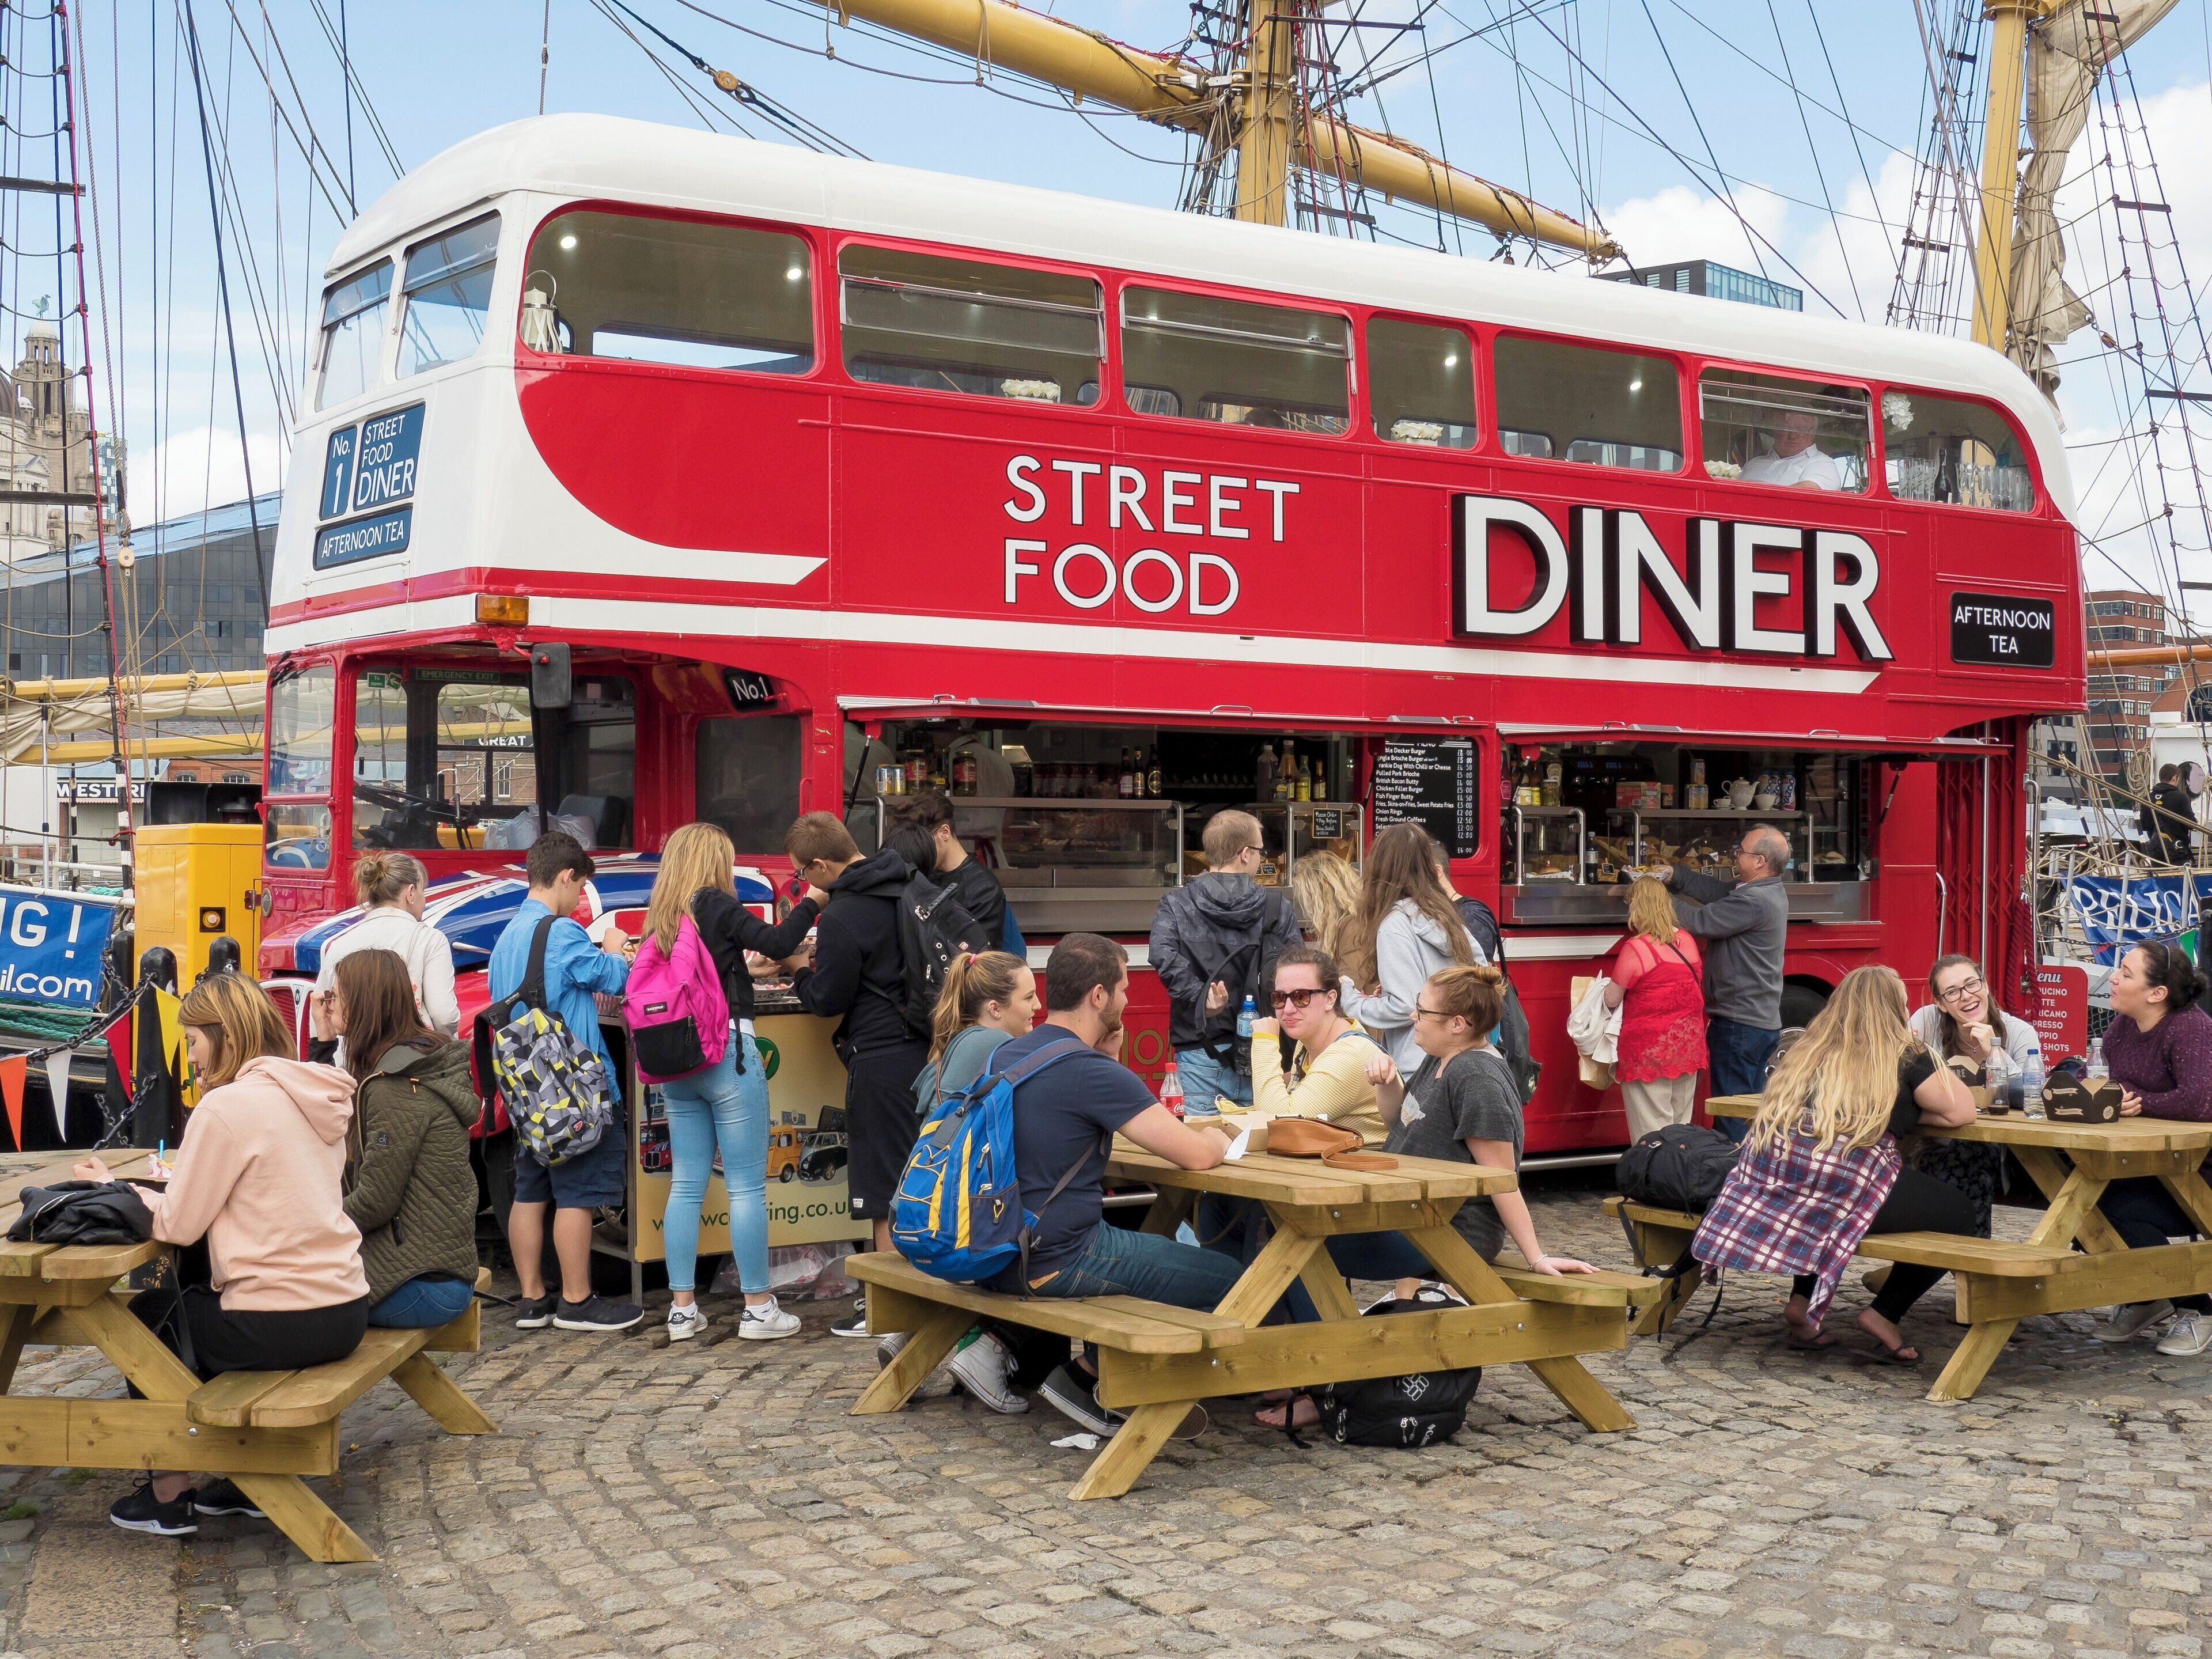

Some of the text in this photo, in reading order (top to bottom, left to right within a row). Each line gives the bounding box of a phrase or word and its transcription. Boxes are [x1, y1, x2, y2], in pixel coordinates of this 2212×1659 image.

[365, 414, 406, 445] STREET
[332, 435, 350, 459] No.
[362, 442, 393, 468] FOOD
[333, 463, 343, 514] 1
[357, 458, 415, 507] DINER
[1002, 454, 1301, 542] STREET
[321, 520, 404, 558] AFTERNOON TEA
[1003, 537, 1240, 616] FOOD
[1451, 493, 1896, 661] DINER
[1955, 605, 2050, 630] AFTERNOON
[1989, 635, 2018, 654] TEA
[422, 670, 494, 680] EMERGENCY EXIT
[1406, 779, 1419, 787] Butty
[2071, 885, 2200, 933] PELICA
[0, 964, 92, 1001] il.com
[2037, 973, 2062, 983] enu
[2032, 1020, 2063, 1029] PRESSO
[2037, 1032, 2058, 1040] OPPIO
[2041, 1054, 2050, 1062] EA
[2043, 1043, 2070, 1052] SHOTS
